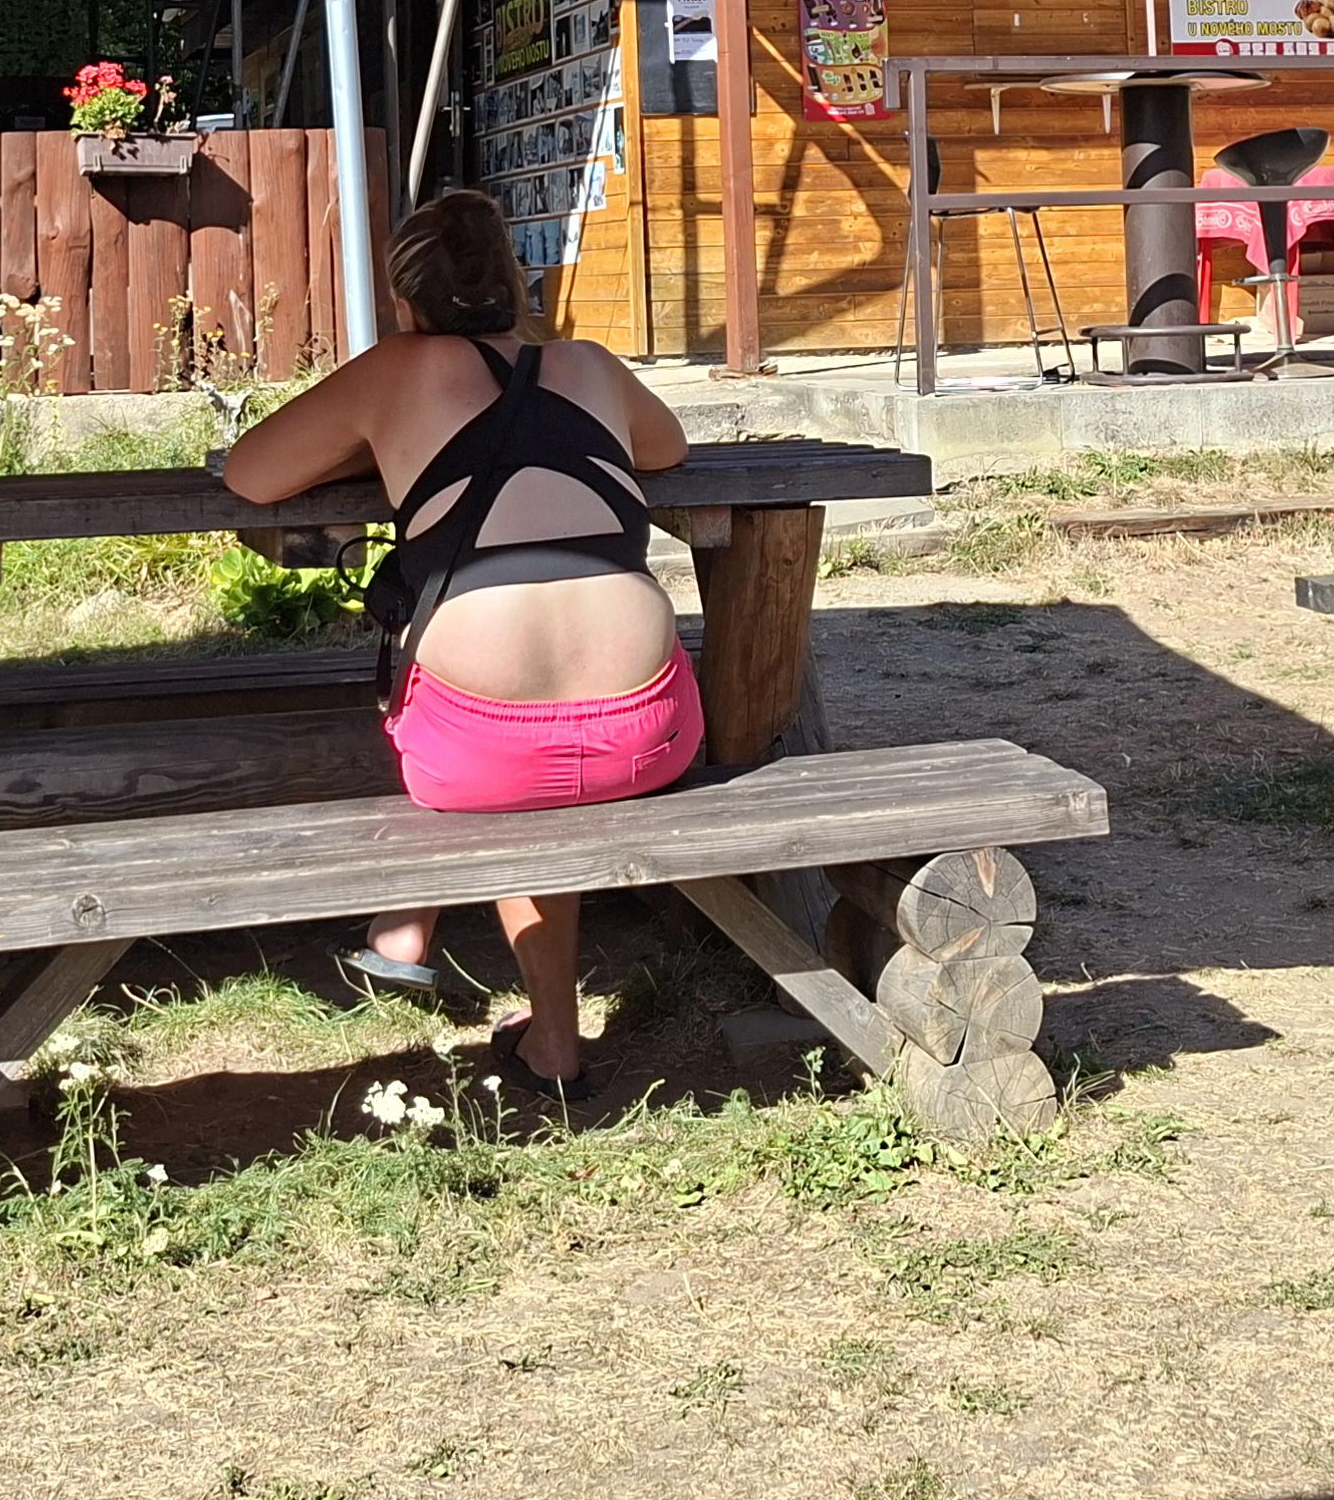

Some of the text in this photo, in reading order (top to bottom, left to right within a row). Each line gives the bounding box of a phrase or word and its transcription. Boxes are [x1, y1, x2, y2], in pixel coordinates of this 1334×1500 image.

[1187, 18, 1303, 37] U NOVÉHO MOSTU
